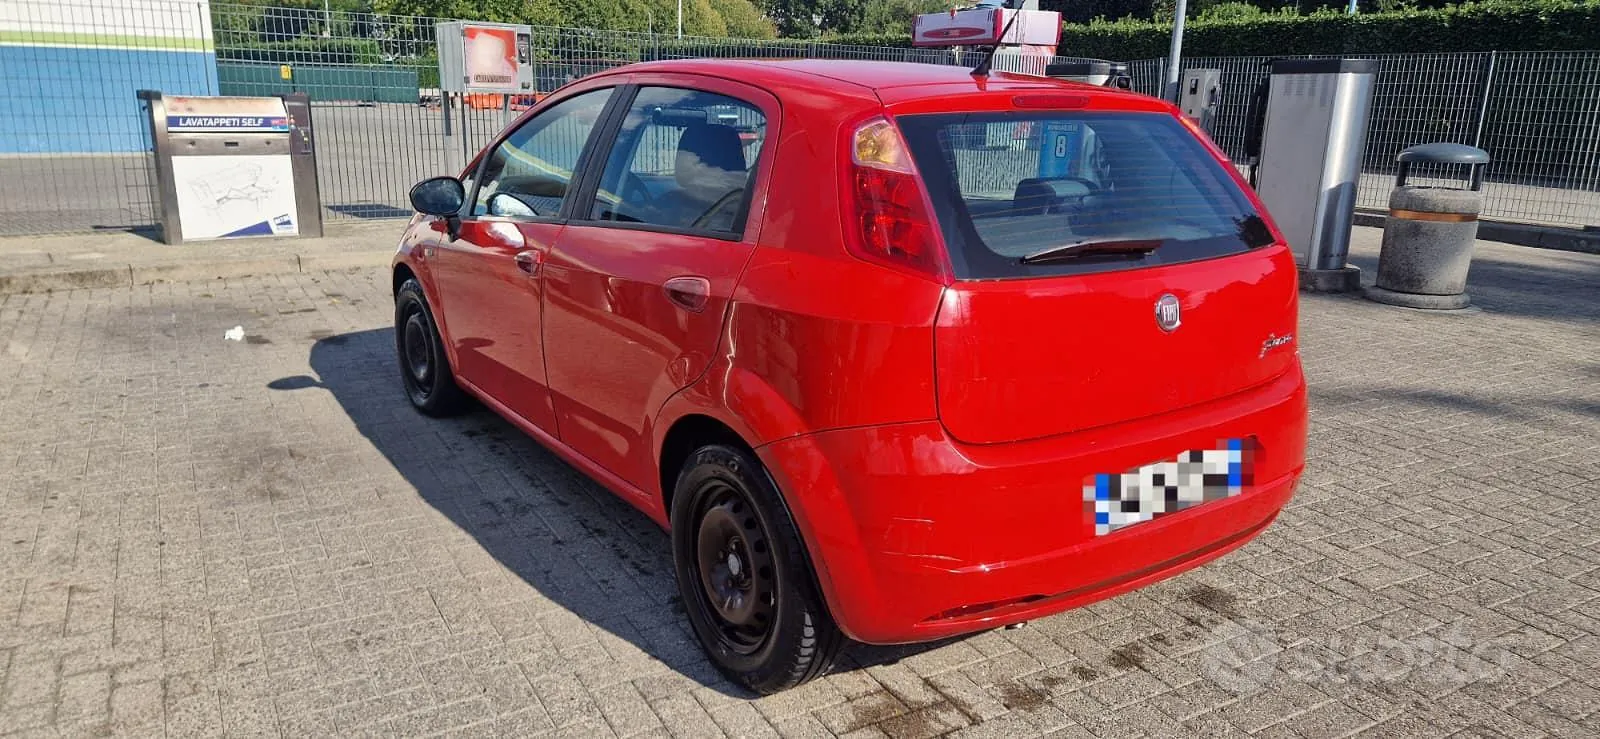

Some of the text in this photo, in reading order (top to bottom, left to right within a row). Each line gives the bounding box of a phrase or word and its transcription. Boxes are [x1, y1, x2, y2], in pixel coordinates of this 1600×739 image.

[179, 117, 240, 127] LAVATAPPETI
[241, 117, 264, 127] SELF
[1161, 303, 1177, 321] FIAT
